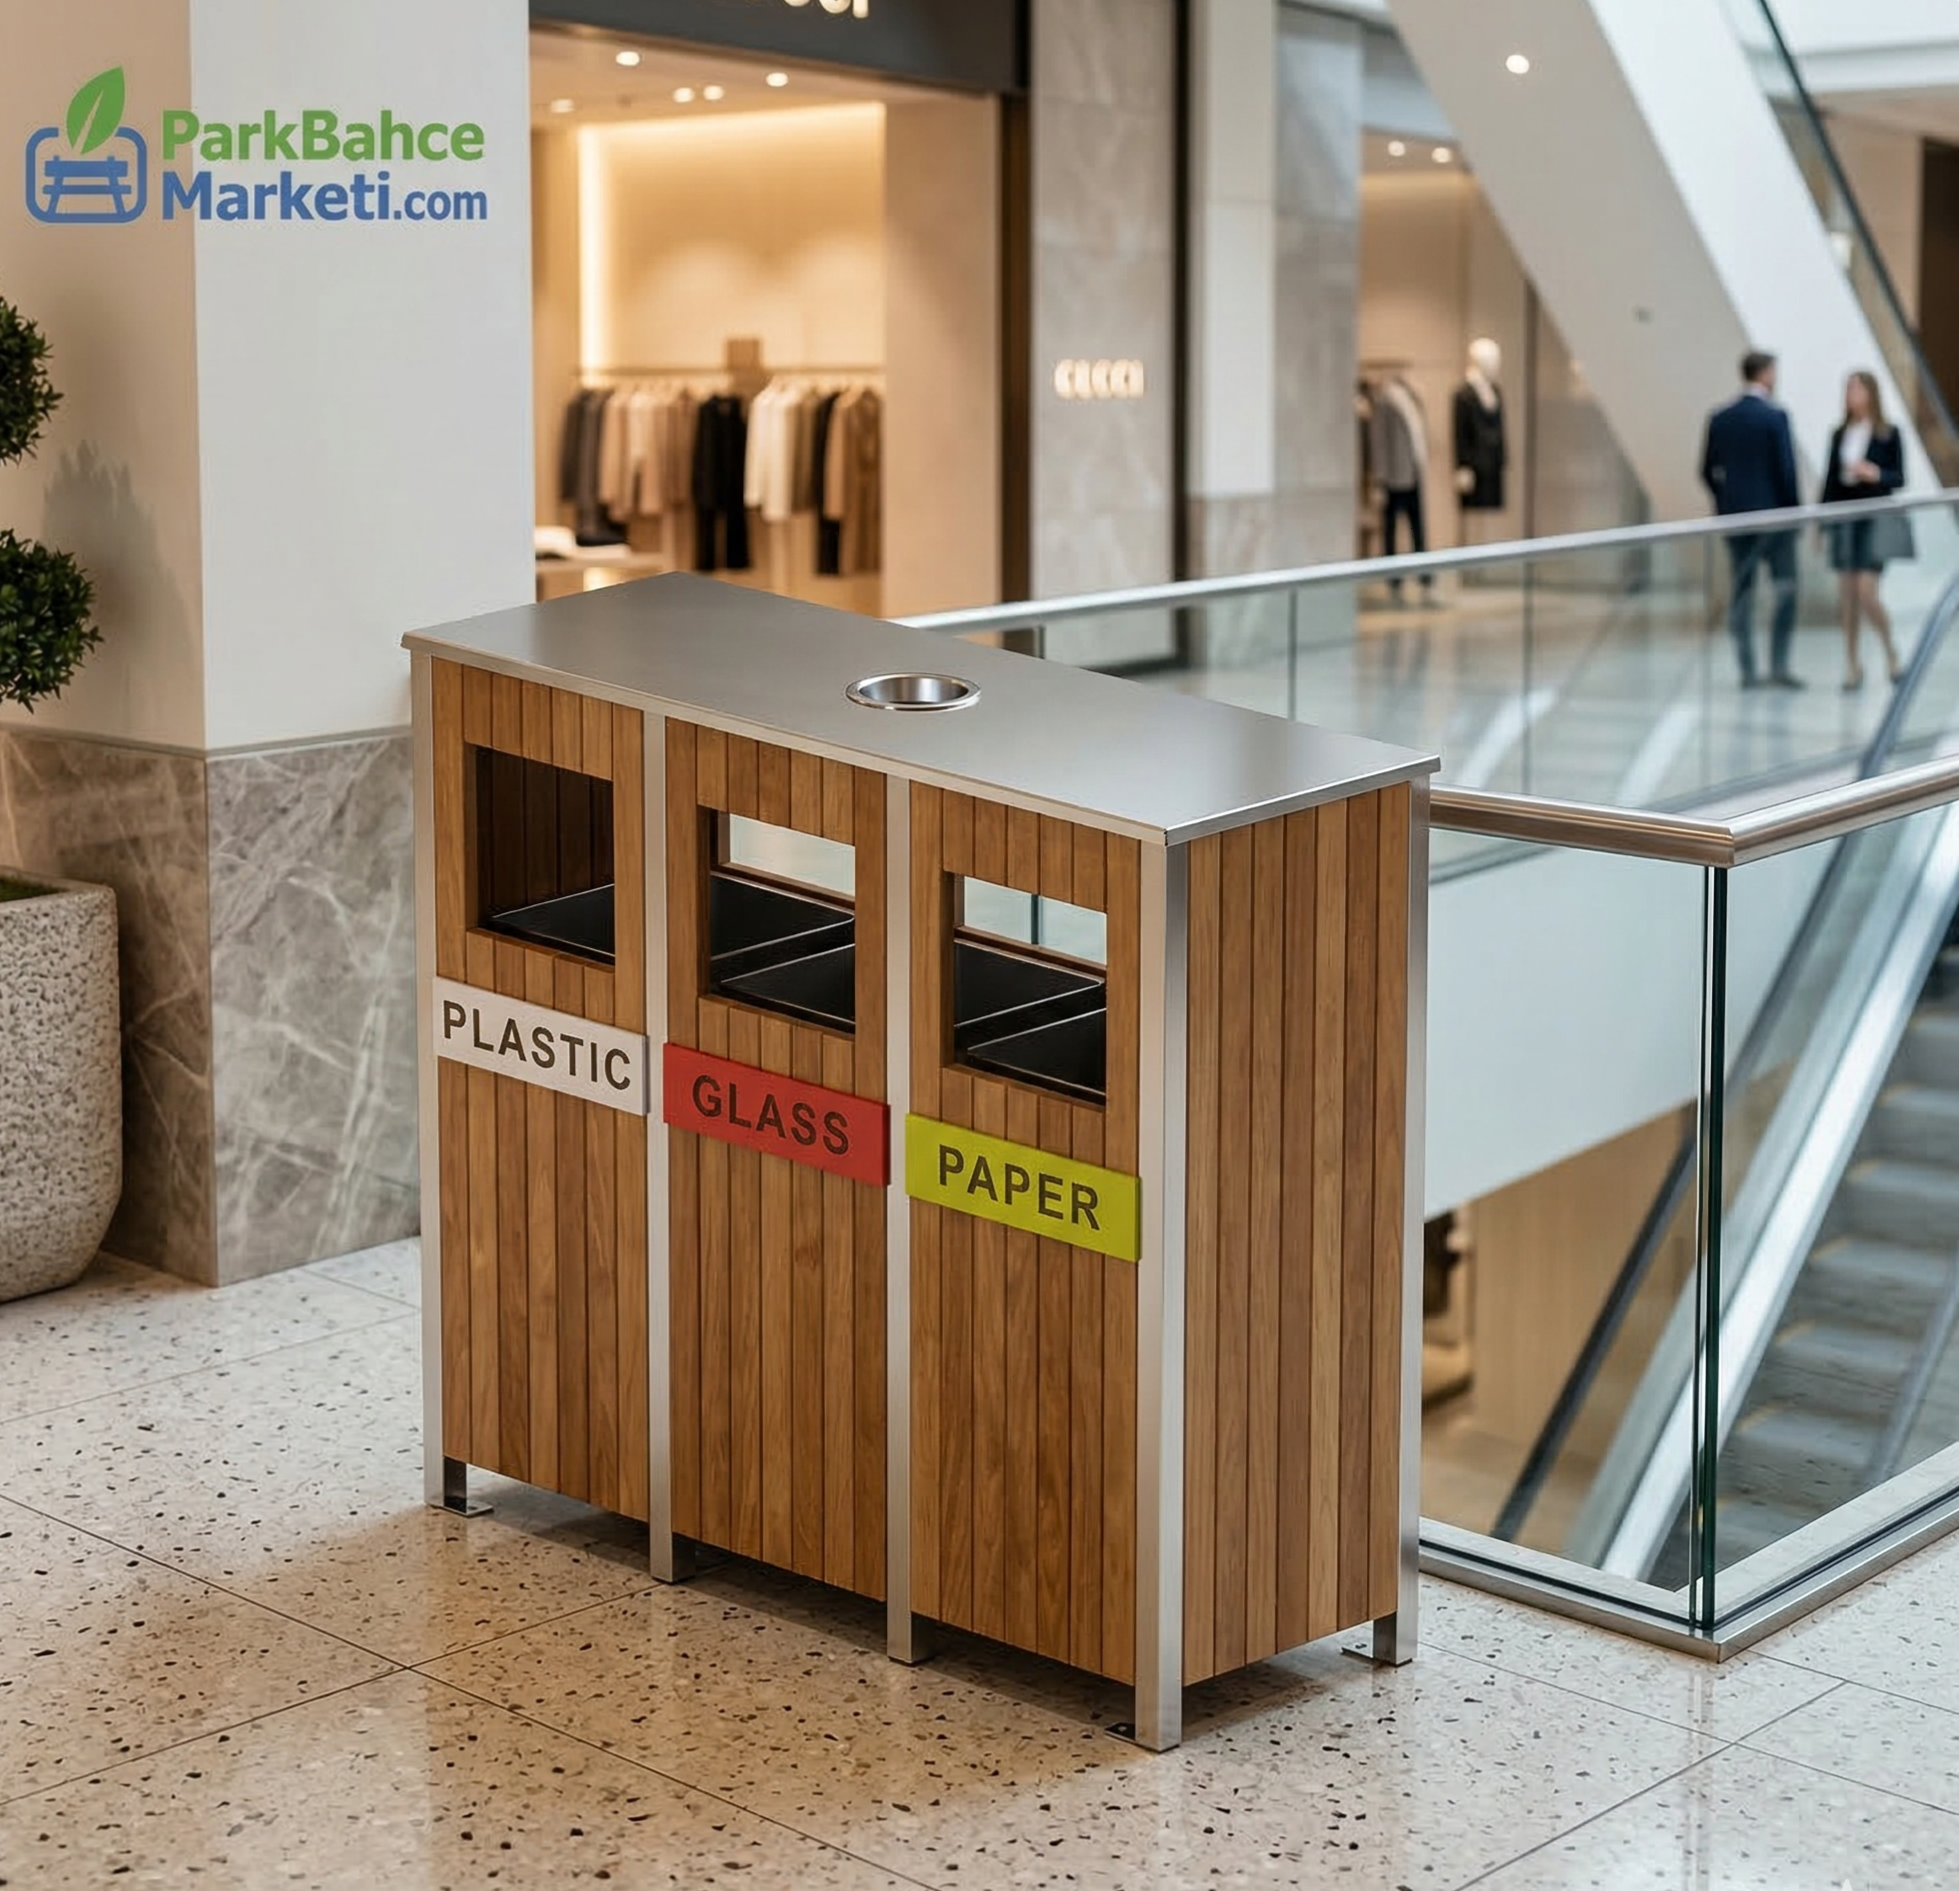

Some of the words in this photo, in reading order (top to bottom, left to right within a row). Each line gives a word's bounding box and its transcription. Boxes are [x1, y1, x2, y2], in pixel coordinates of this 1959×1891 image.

[442, 999, 632, 1092] PLASTIC
[692, 1074, 850, 1156] GLASS
[938, 1143, 1100, 1231] PAPER
